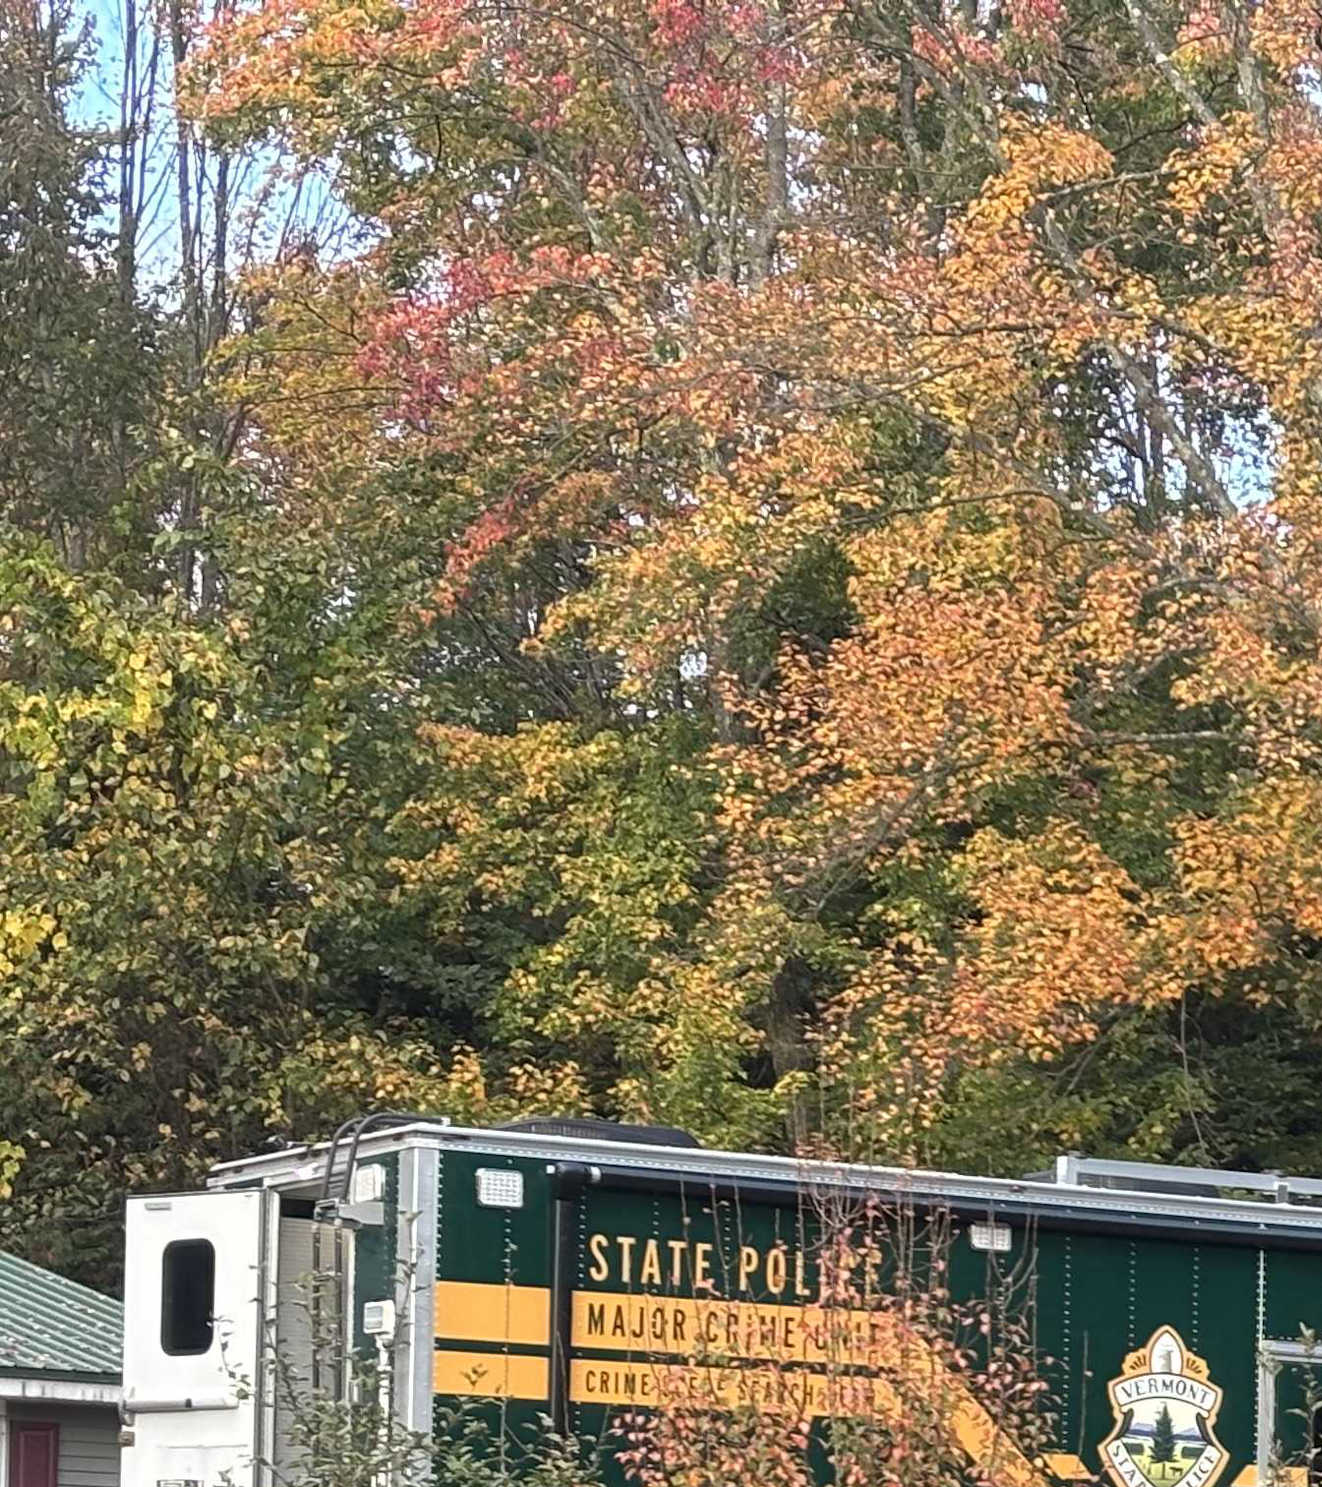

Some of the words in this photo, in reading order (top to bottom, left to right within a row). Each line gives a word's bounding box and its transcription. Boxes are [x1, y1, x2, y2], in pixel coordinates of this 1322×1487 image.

[589, 1233, 713, 1287] STATE
[587, 1302, 687, 1341] MAJOR
[586, 1369, 650, 1396] CRIME
[1121, 1377, 1210, 1404] VERMONT
